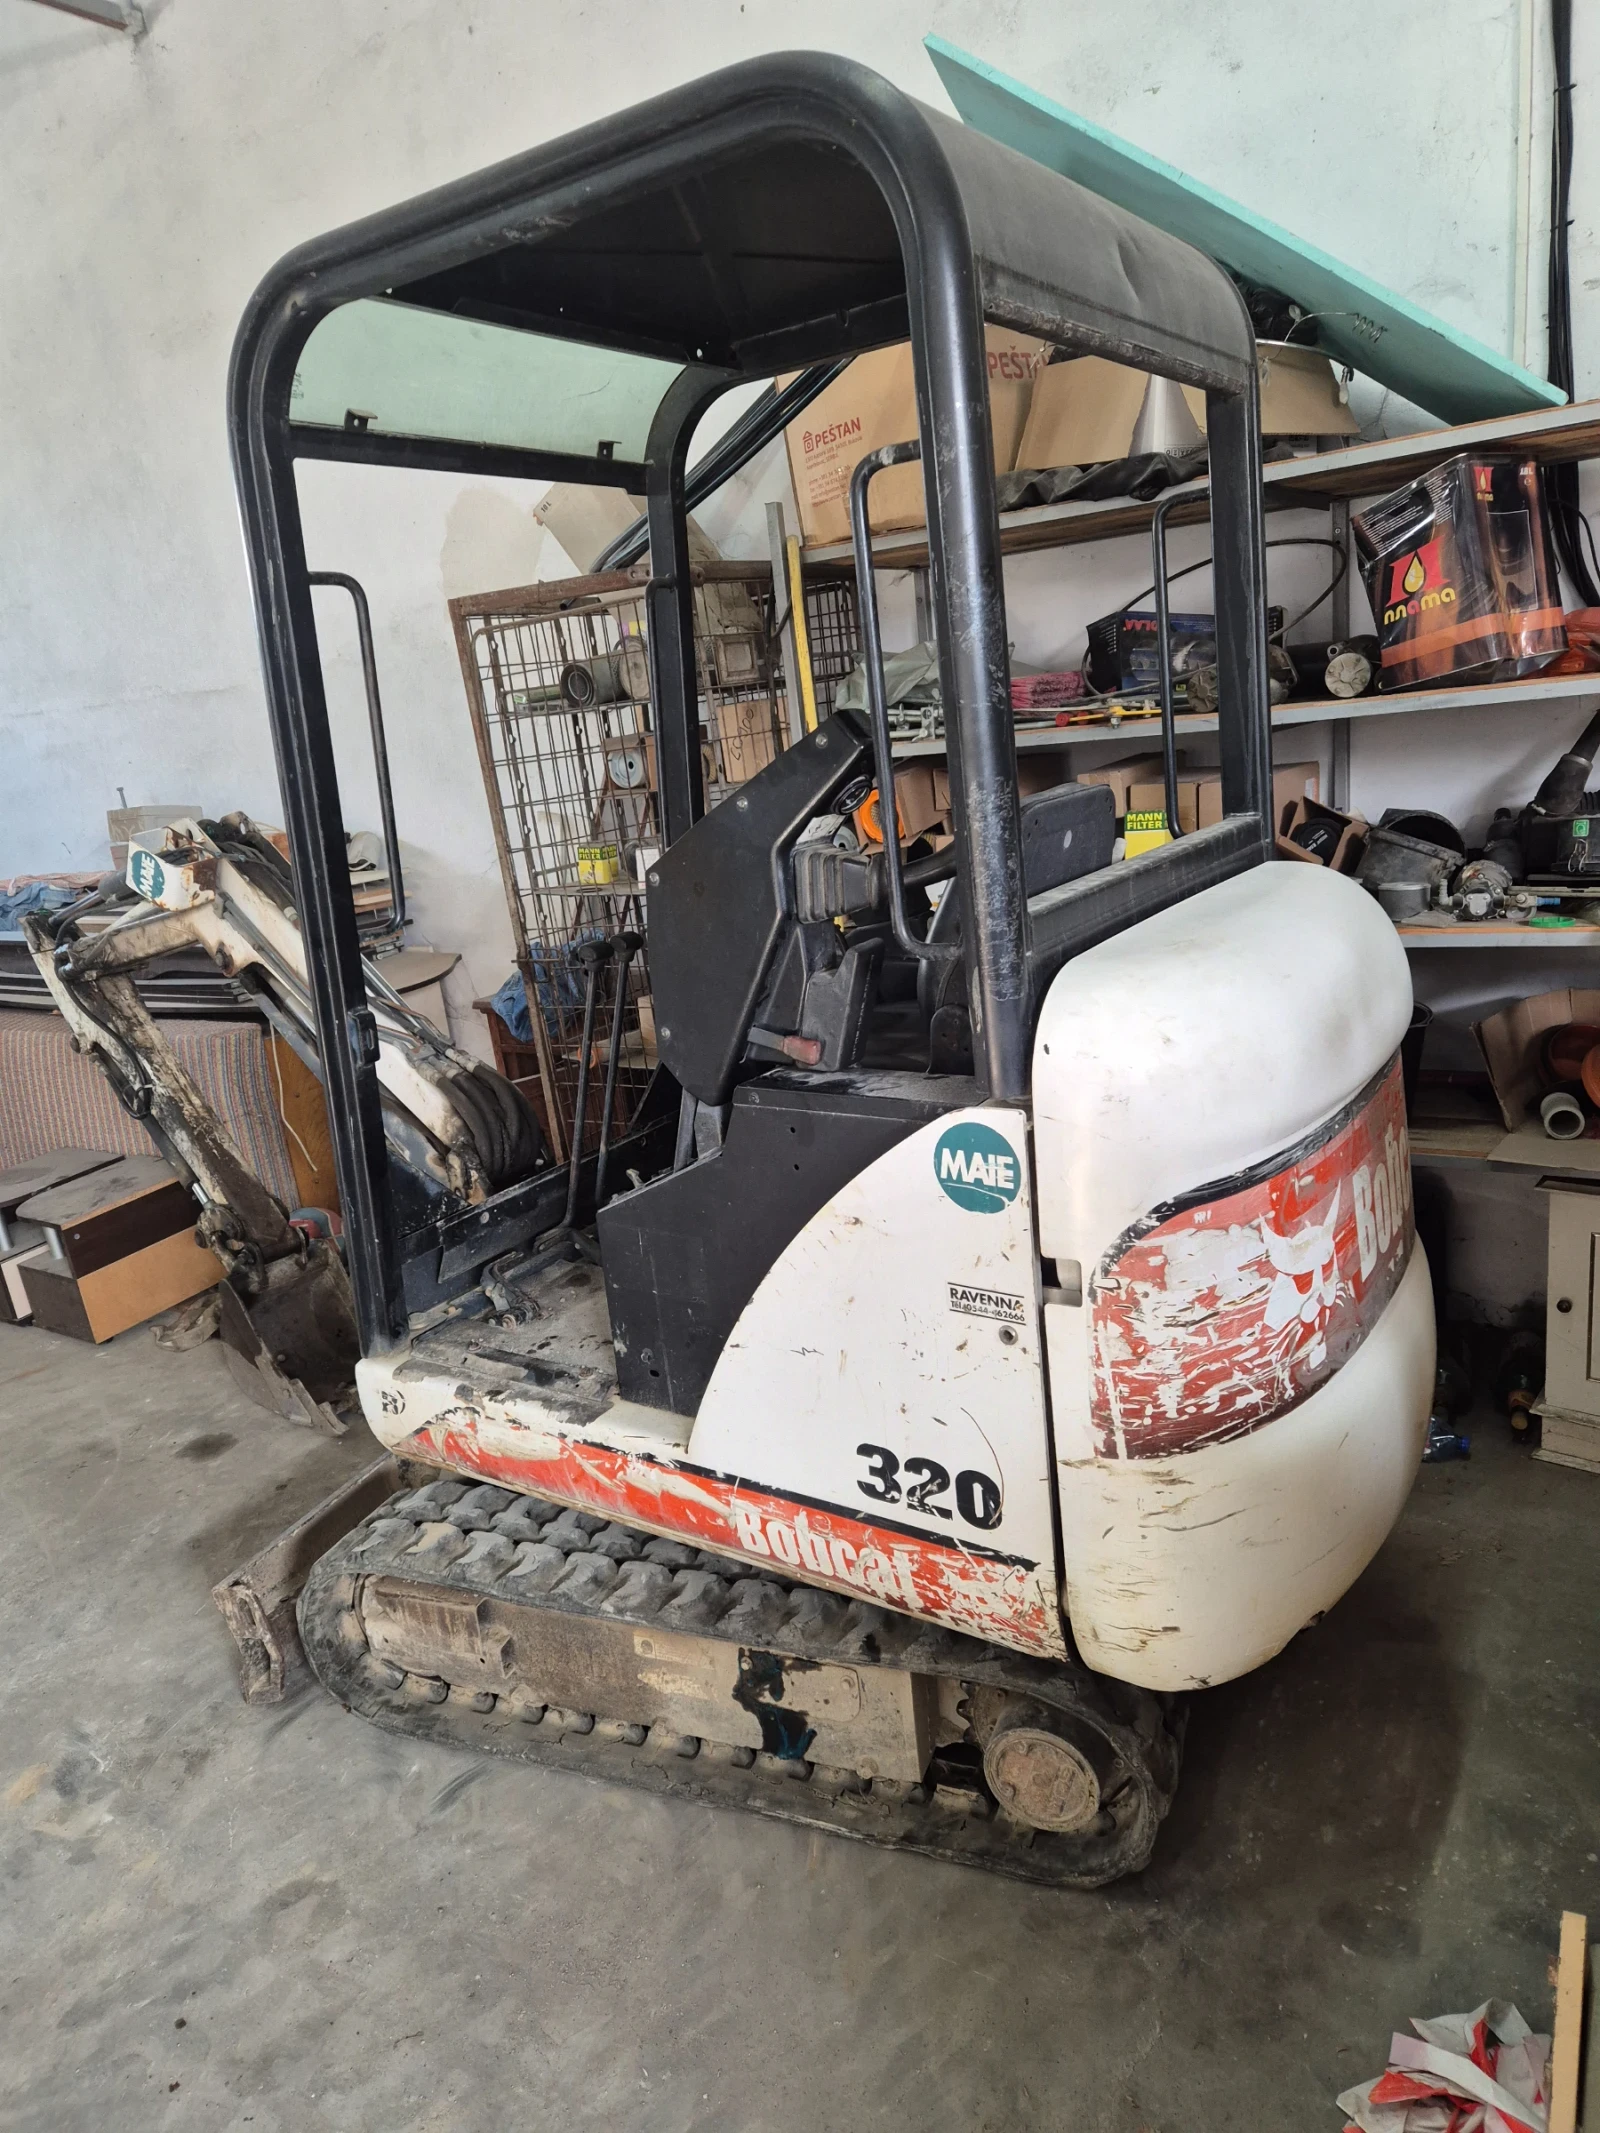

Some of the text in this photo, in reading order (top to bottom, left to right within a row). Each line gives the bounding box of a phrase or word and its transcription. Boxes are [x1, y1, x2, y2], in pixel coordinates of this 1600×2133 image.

[815, 417, 862, 448] PEŠTAN
[1127, 812, 1163, 822] MANN
[1127, 820, 1163, 830] FILTER
[940, 1147, 1015, 1189] MAIE
[949, 1287, 1025, 1313] RAVENNA
[856, 1442, 1003, 1531] 320
[735, 1504, 923, 1609] Bobcat
